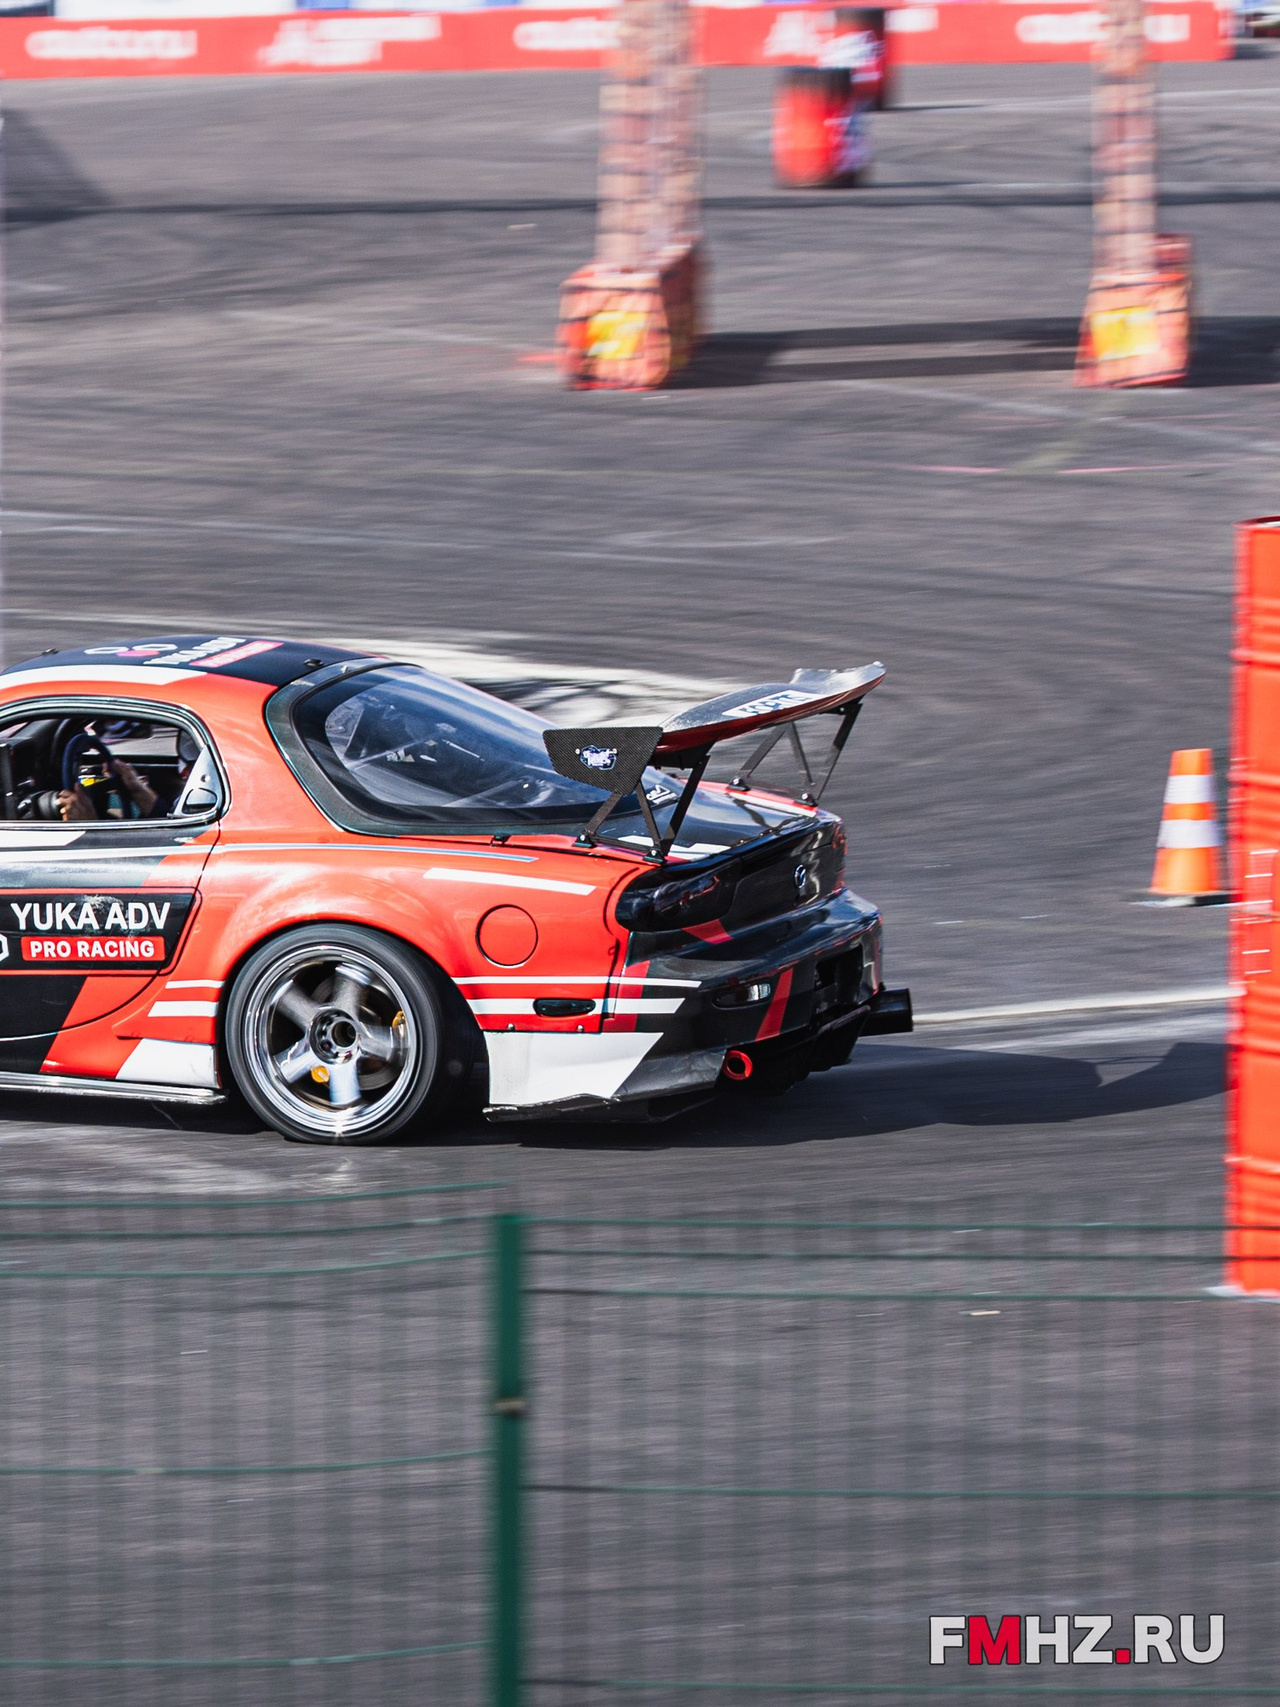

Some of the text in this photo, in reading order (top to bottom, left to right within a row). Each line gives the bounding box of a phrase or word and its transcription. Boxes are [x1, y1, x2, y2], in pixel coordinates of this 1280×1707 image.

[10, 902, 170, 930] YUKA ADV
[30, 940, 154, 958] PRO RACING
